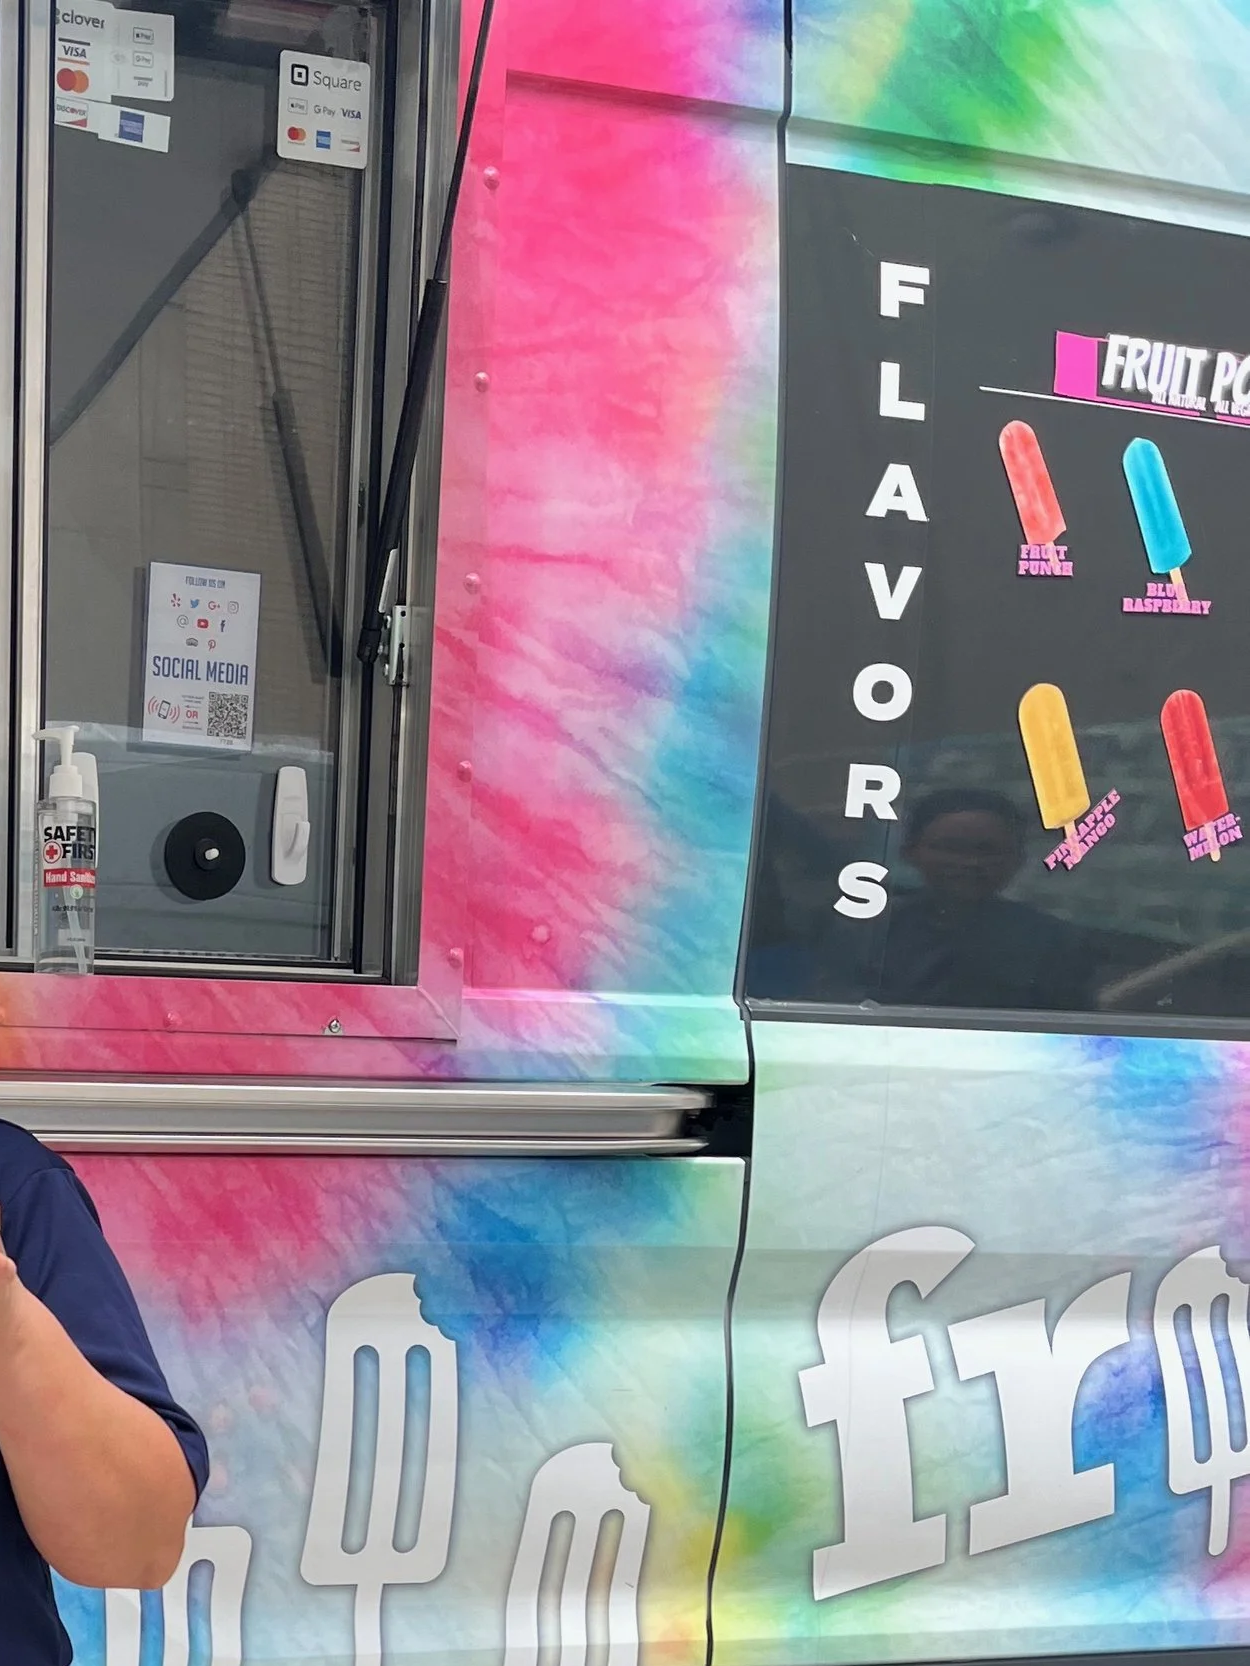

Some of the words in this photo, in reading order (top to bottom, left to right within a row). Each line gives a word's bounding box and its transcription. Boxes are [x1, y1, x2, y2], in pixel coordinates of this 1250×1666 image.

[61, 9, 105, 29] clover
[62, 45, 87, 58] VISA
[313, 70, 362, 92] Square
[341, 107, 362, 120] VISA
[1101, 332, 1208, 396] FRUIT
[833, 260, 931, 920] FLAVORS
[1122, 597, 1212, 615] RASPBERRY
[152, 655, 202, 681] SOCIAL
[206, 660, 249, 686] MEDIA
[185, 709, 199, 720] OR
[45, 870, 68, 884] Hand
